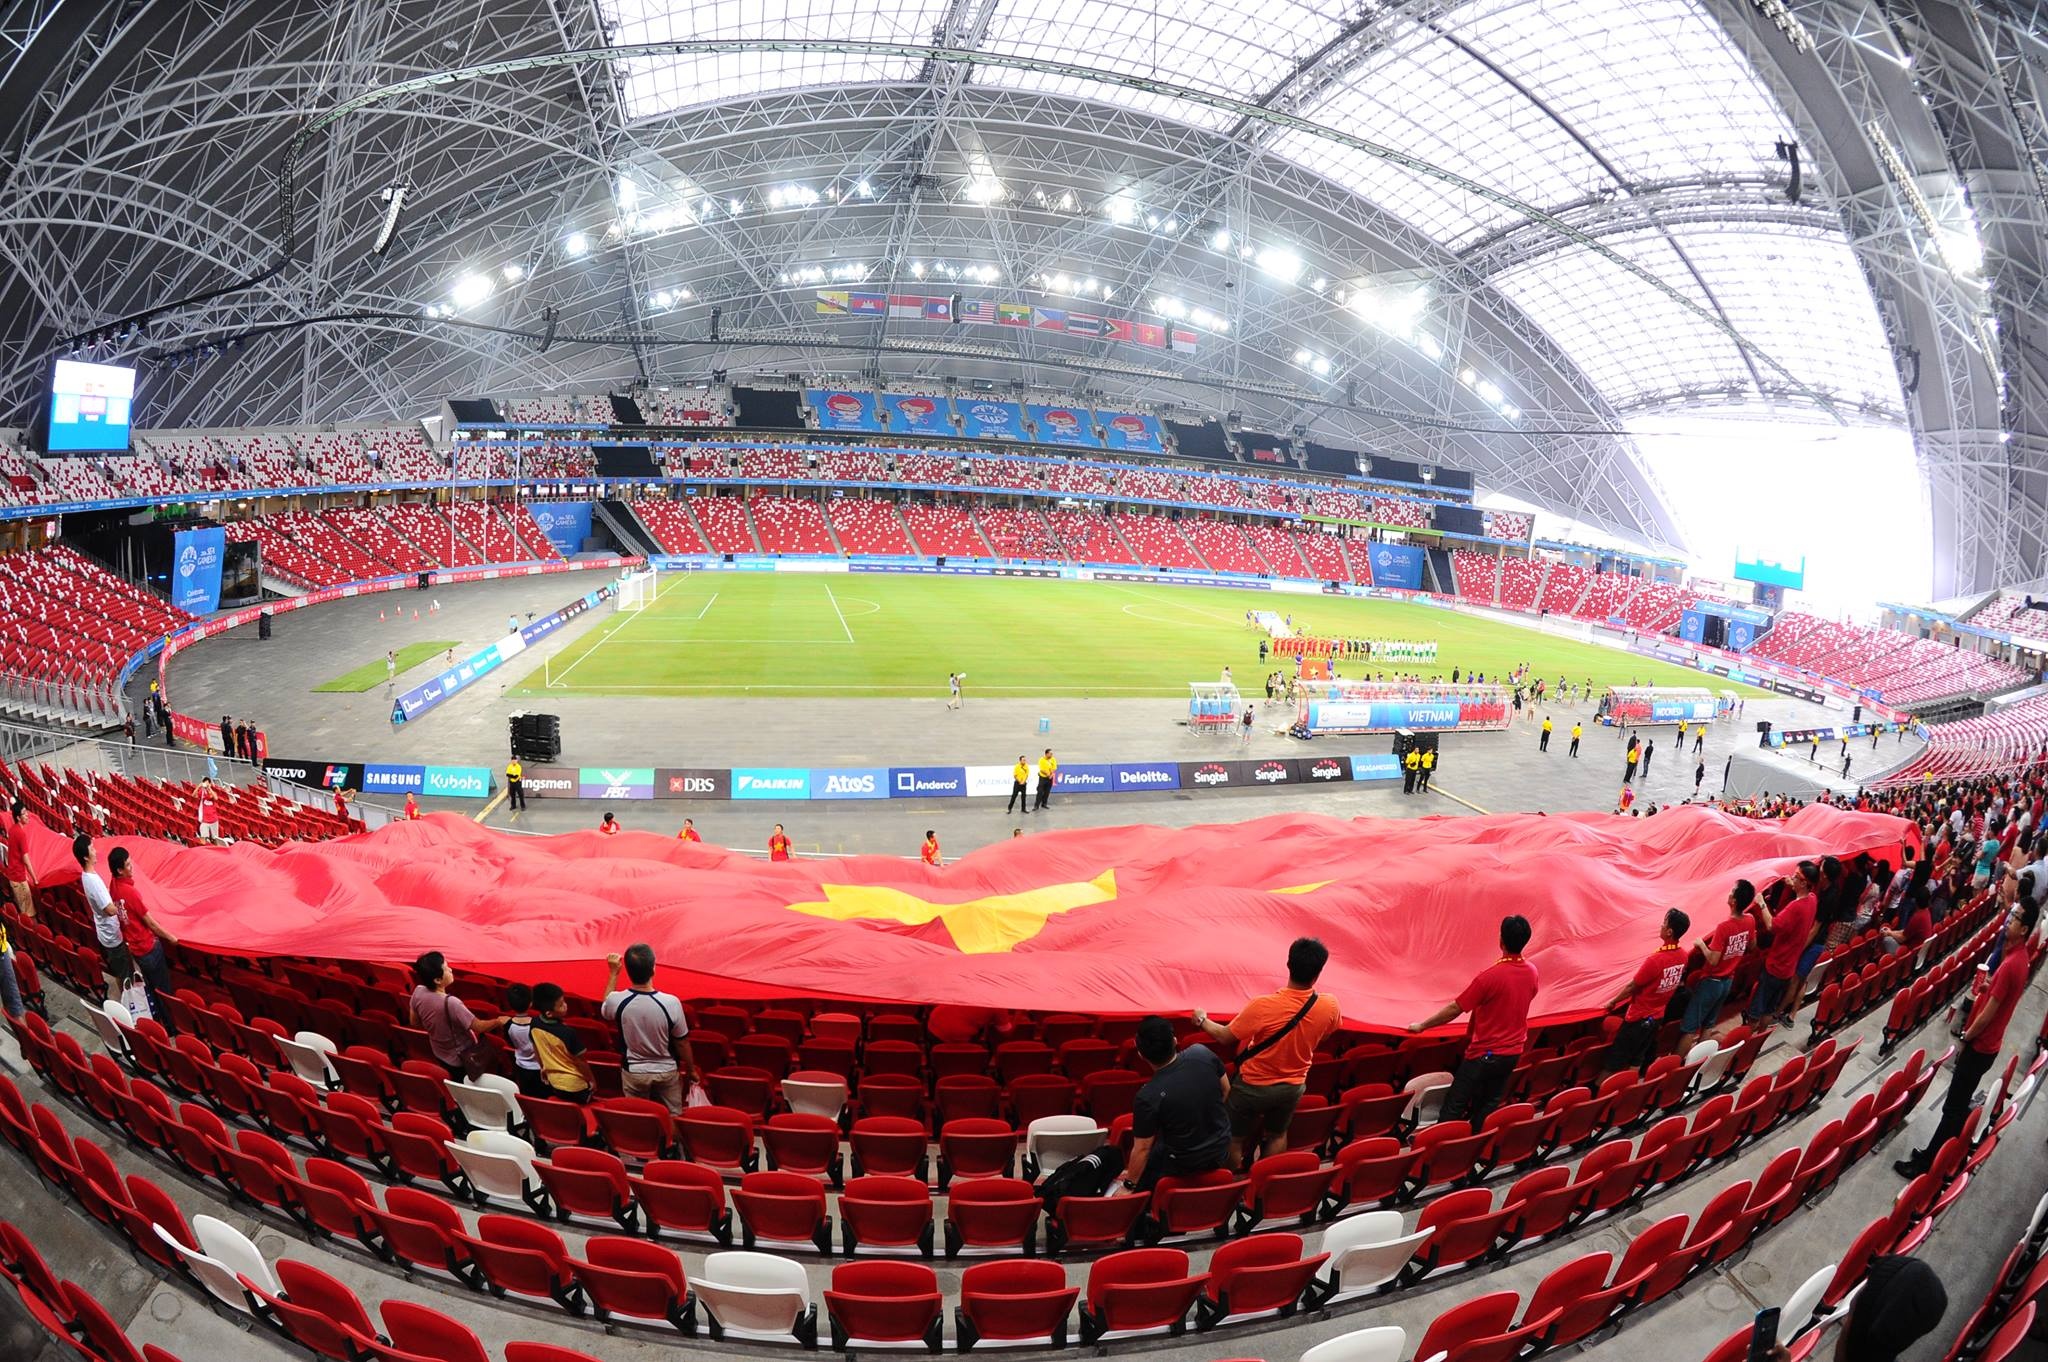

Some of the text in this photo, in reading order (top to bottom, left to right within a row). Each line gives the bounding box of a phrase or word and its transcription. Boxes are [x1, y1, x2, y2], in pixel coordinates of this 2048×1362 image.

[1408, 710, 1454, 722] VIETNAM
[265, 767, 306, 779] VOLVO
[366, 773, 421, 785] SAMSUNG
[1064, 774, 1105, 784] FairPrice
[1120, 771, 1172, 783] Deloitte.
[1194, 772, 1228, 785] Singtel
[1255, 769, 1287, 783] Singtel
[1311, 766, 1341, 780] Singtel
[430, 773, 482, 790] Kubota
[521, 778, 572, 791] ingsmen
[684, 778, 715, 792] DBS
[751, 778, 804, 789] DAIKIN
[916, 780, 957, 790] Anderco
[1729, 930, 1749, 945] VIET
[1725, 941, 1748, 955] NAM
[1663, 963, 1685, 978] VIET
[1660, 975, 1682, 988] NAM
